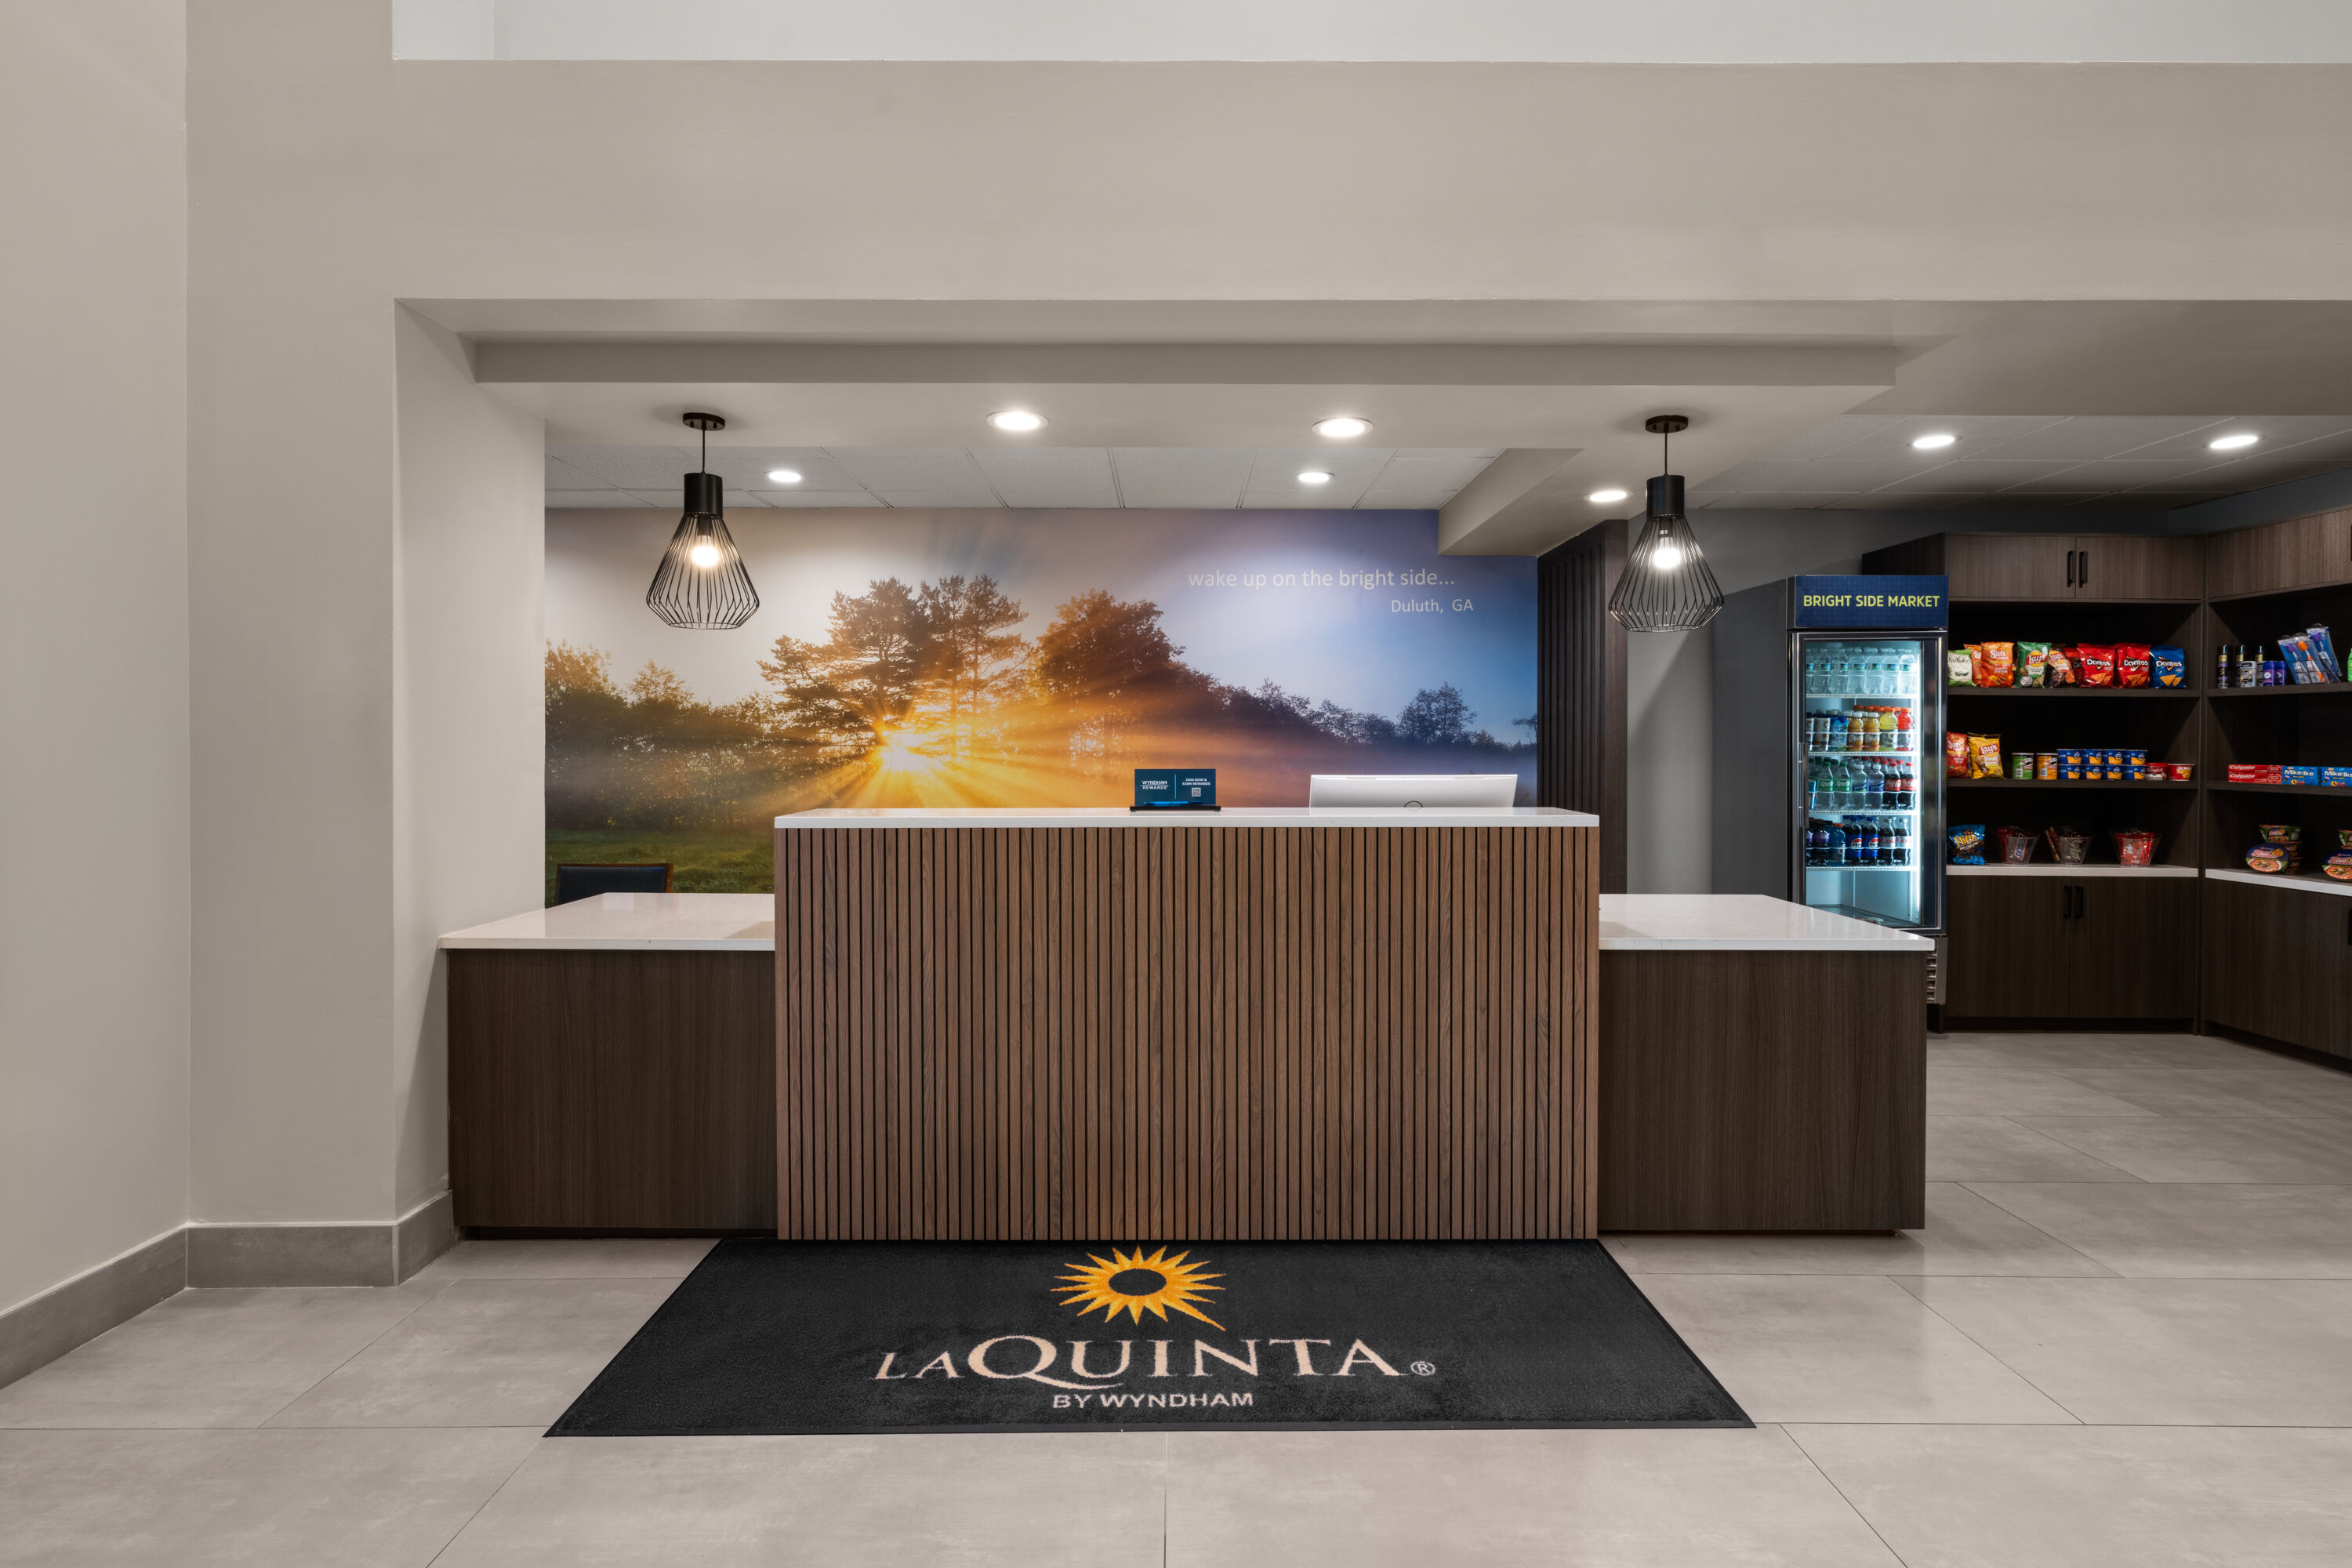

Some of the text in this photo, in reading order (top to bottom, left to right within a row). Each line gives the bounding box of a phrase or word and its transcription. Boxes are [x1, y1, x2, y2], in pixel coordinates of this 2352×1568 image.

[1188, 570, 1237, 586] wake
[1243, 574, 1267, 590] up
[1272, 574, 1296, 586] on
[1301, 569, 1333, 586] the
[1339, 568, 1395, 590] bright
[1391, 597, 1475, 615] Duluth, GA
[1803, 594, 1940, 608] BRIGHT SIDE MARKET
[1980, 744, 1998, 754] Lay's
[1052, 1392, 1254, 1409] BY WYNDHAM
